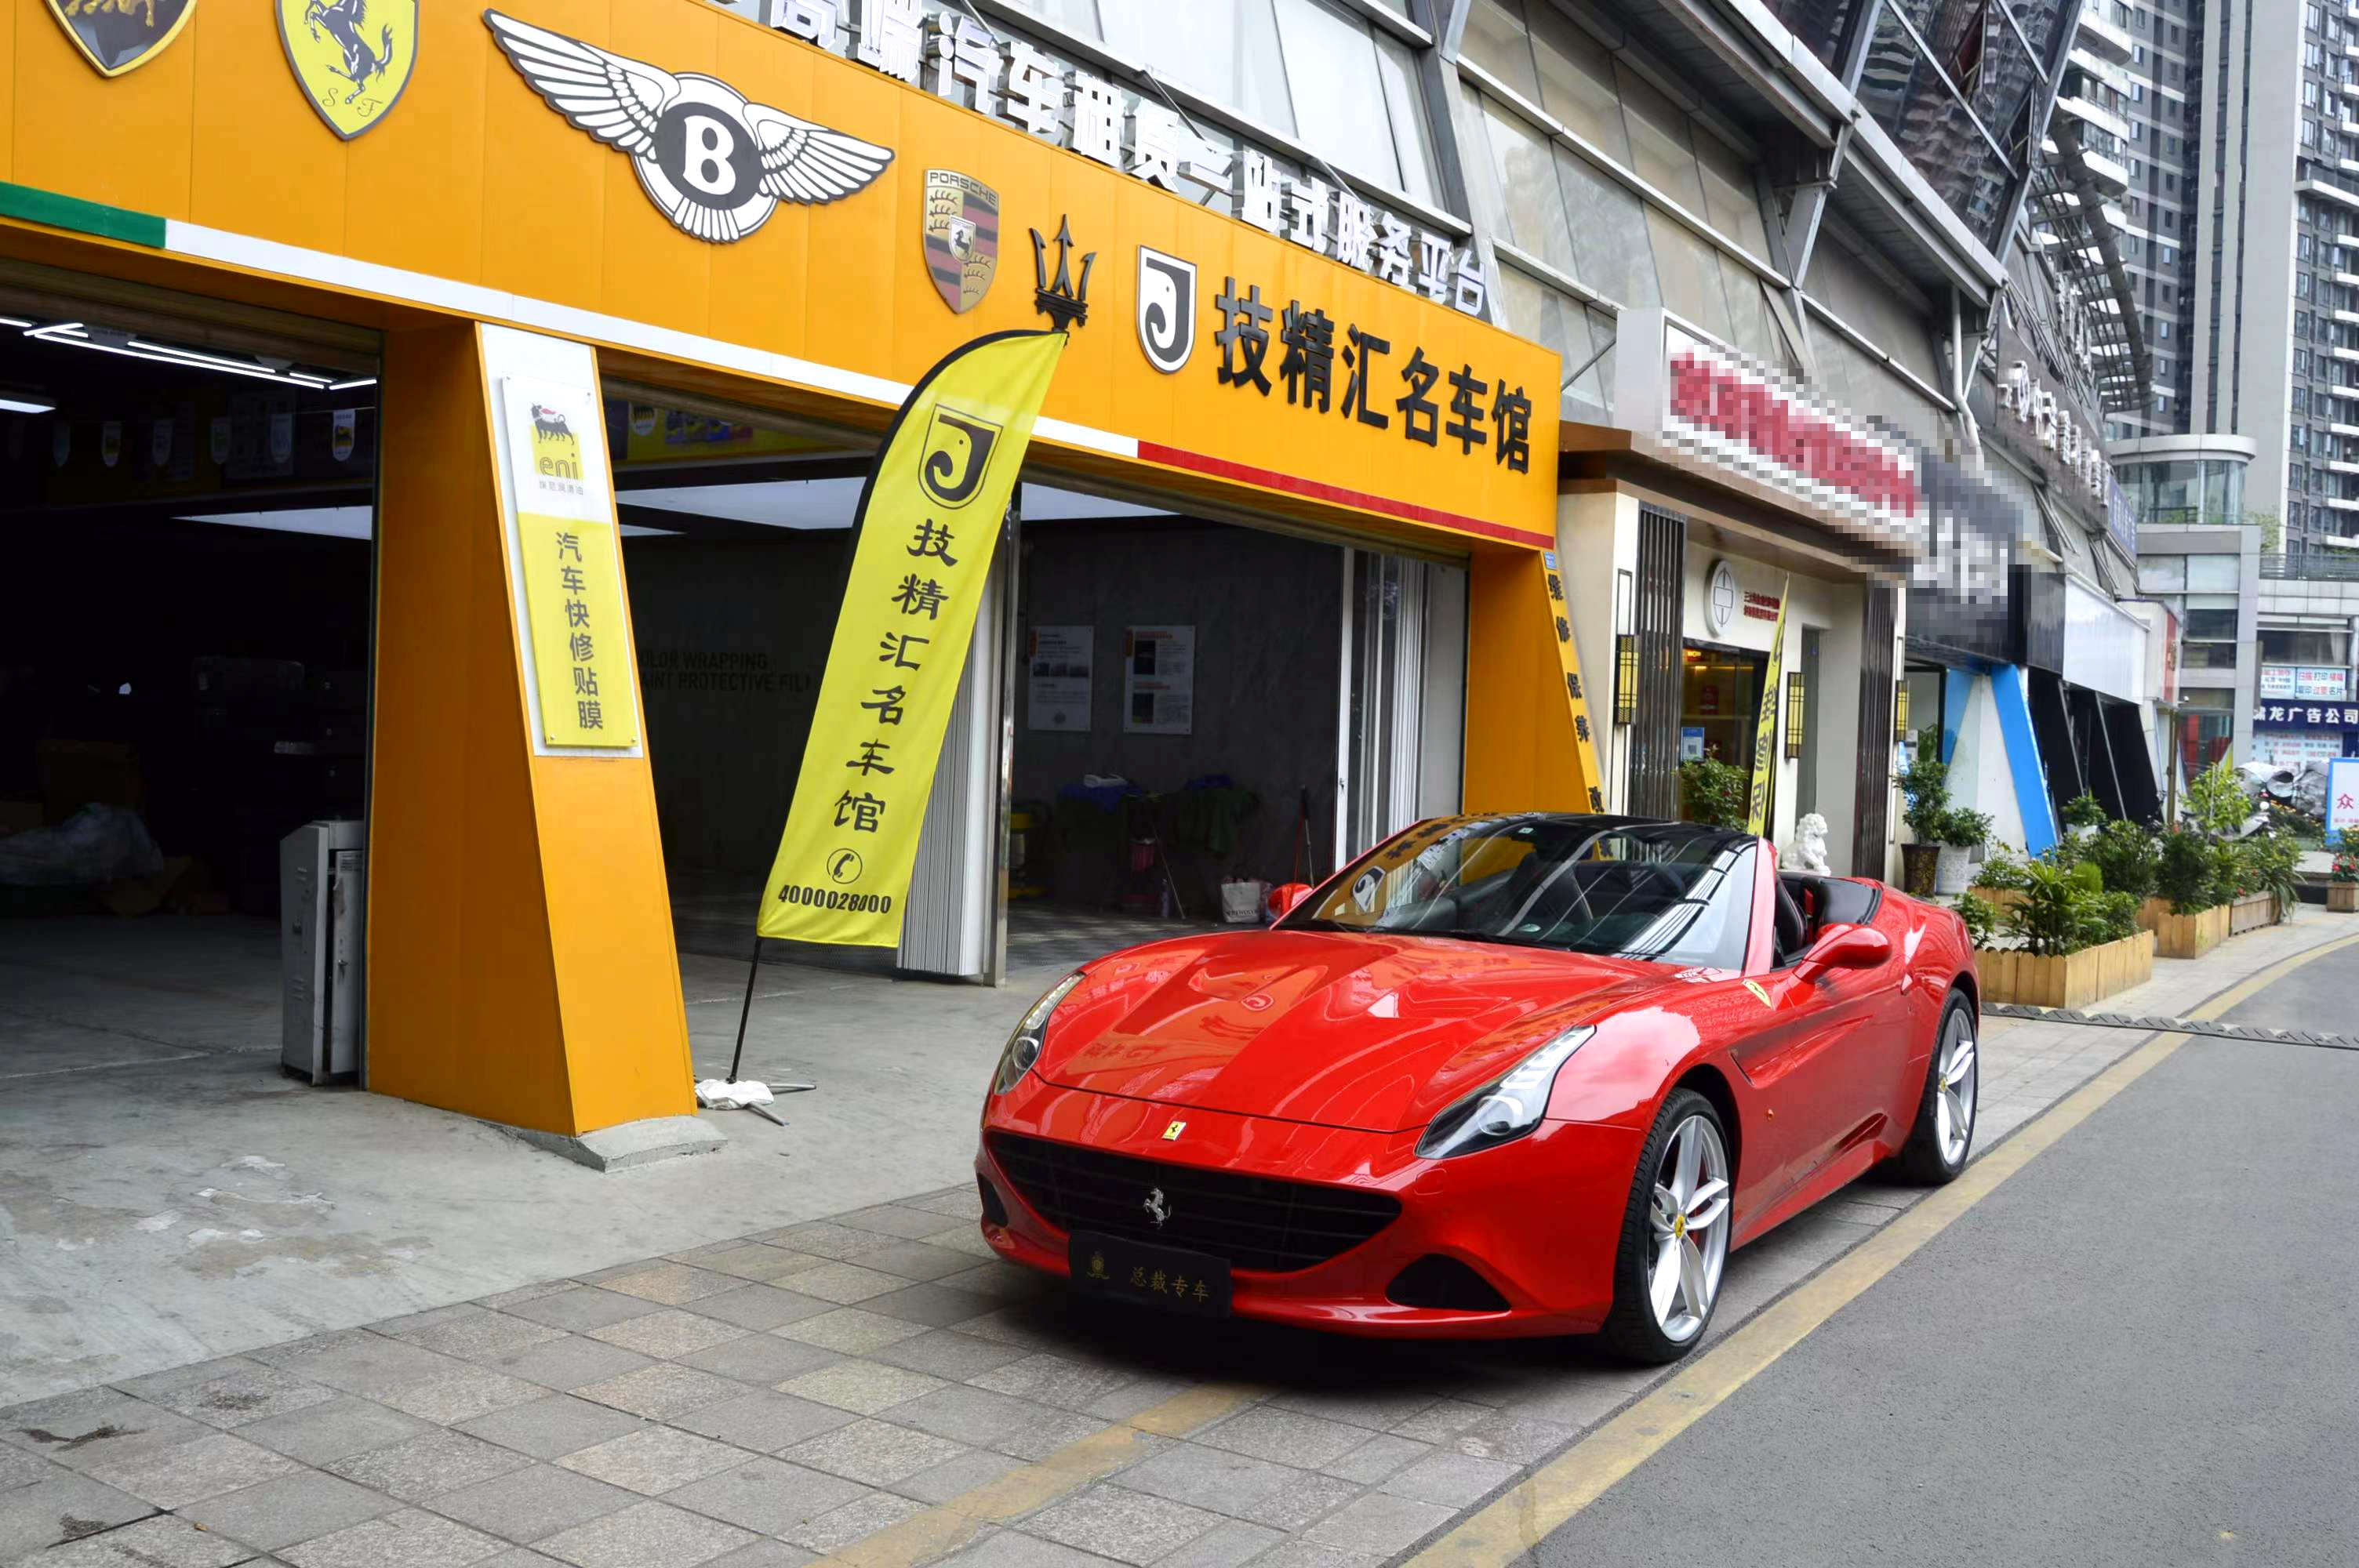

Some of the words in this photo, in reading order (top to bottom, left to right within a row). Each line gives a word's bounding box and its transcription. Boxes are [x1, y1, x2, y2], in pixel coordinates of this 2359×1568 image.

[682, 114, 736, 196] B
[930, 171, 998, 206] PORSCHE
[1214, 275, 1533, 475] 技精汇名车馆
[539, 452, 579, 480] eni
[555, 531, 604, 730] 汽车快修贴膜
[639, 650, 678, 669] OLOR
[682, 651, 768, 671] WRAPPING
[833, 517, 959, 834] 技精汇名车馆
[641, 670, 674, 690] AINT
[678, 671, 774, 692] PROTECTIVE
[2336, 793, 2354, 809] 众
[1130, 1265, 1210, 1303] 总裁专车
